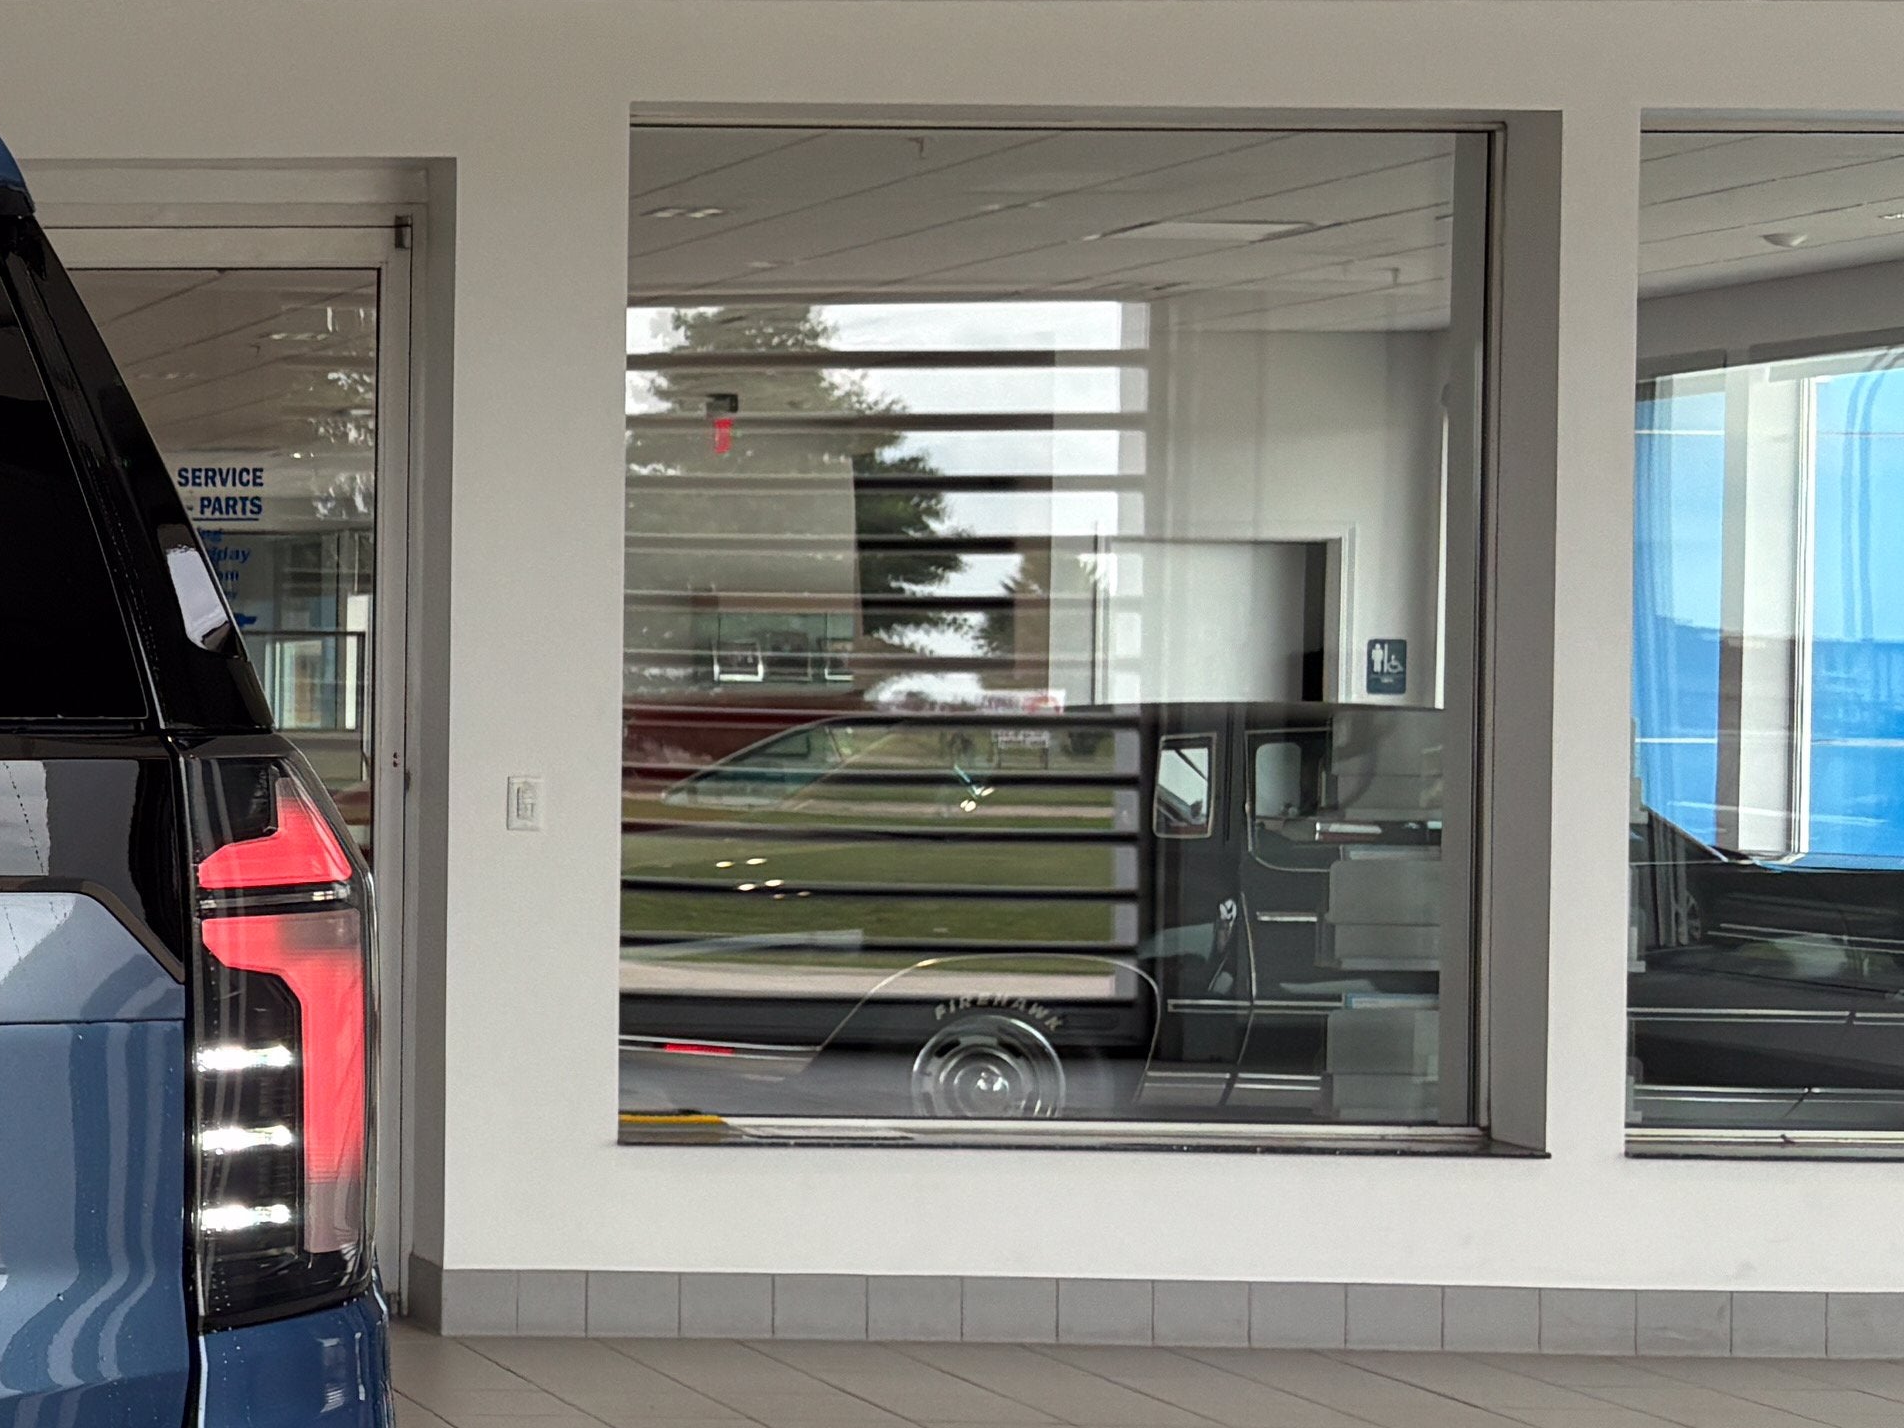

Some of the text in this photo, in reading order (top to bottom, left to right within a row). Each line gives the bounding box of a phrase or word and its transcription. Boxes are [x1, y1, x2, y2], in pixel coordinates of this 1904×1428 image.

[178, 467, 264, 487] SERVICE
[200, 496, 263, 515] PARTS
[934, 994, 1064, 1031] FIREHAWK
